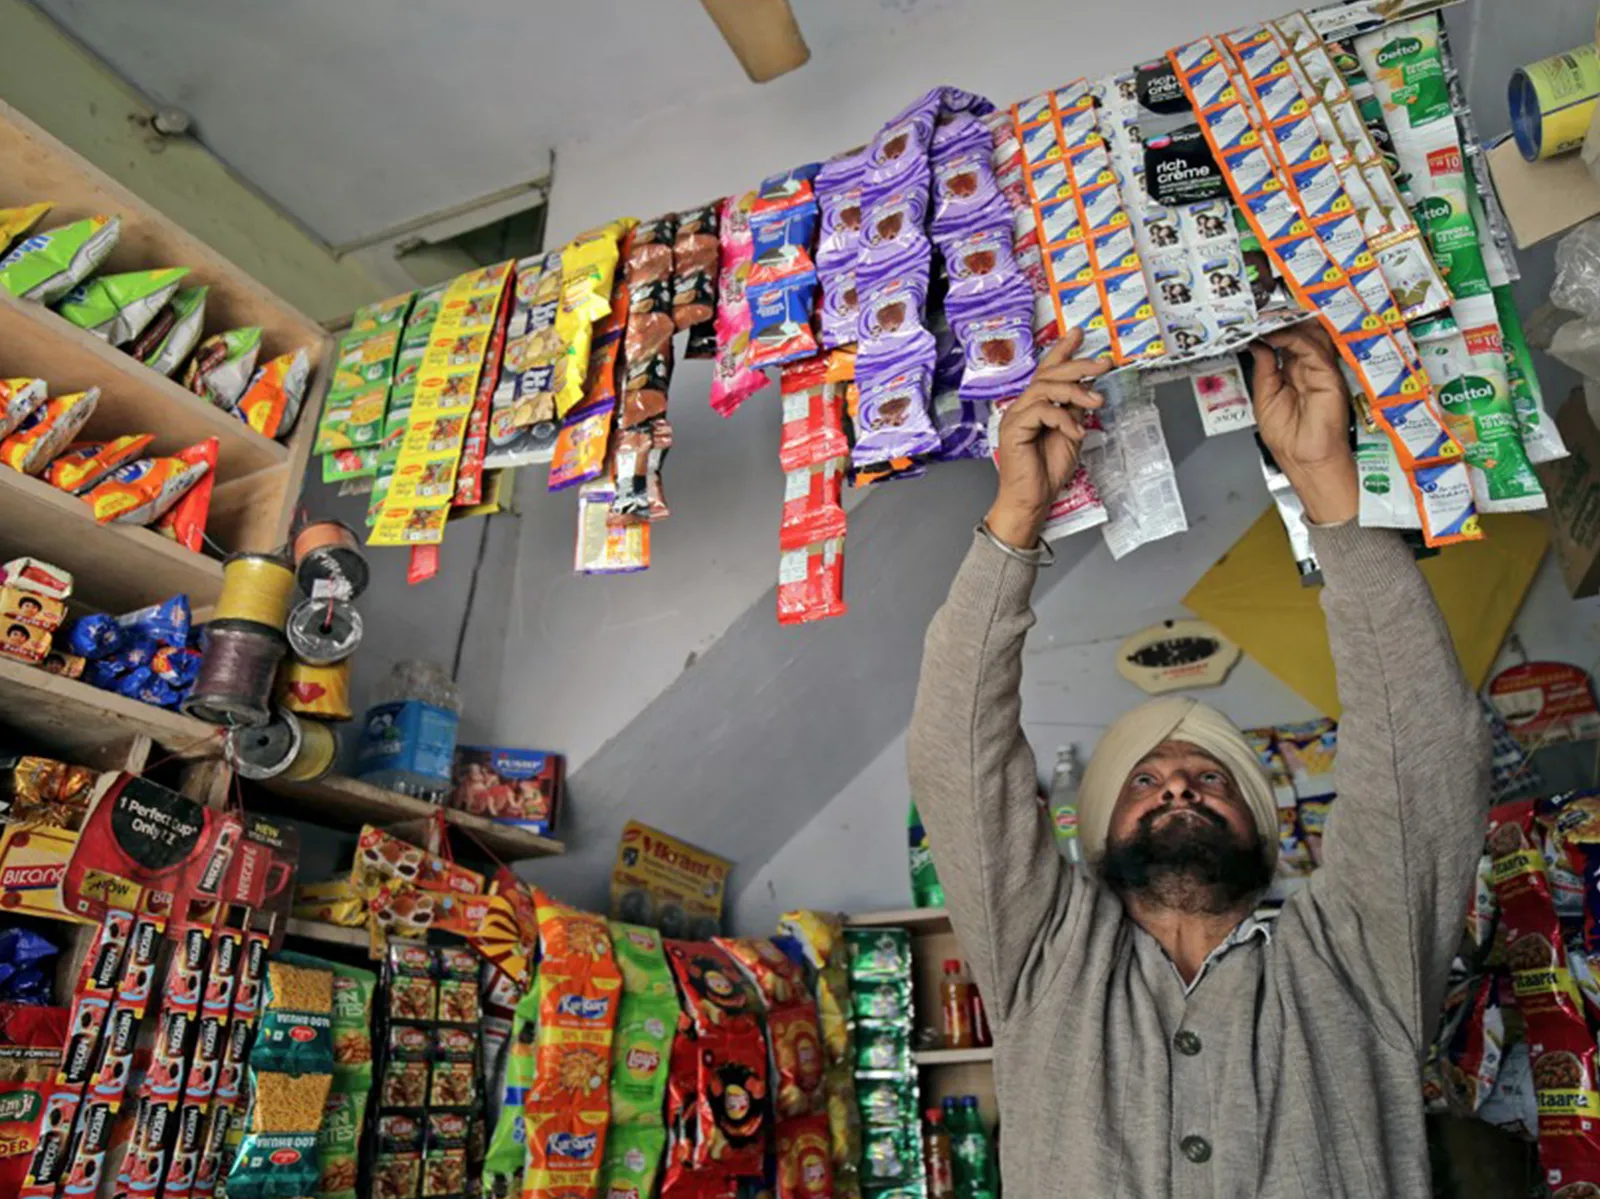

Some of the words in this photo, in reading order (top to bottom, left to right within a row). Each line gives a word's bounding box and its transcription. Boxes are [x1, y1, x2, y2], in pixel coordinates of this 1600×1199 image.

[1378, 41, 1421, 64] Dettol
[1147, 74, 1176, 87] rich
[1156, 158, 1188, 174] rich
[1440, 384, 1494, 405] Dettol
[128, 799, 171, 827] Perfect
[132, 820, 160, 841] Only
[254, 822, 280, 839] NEW
